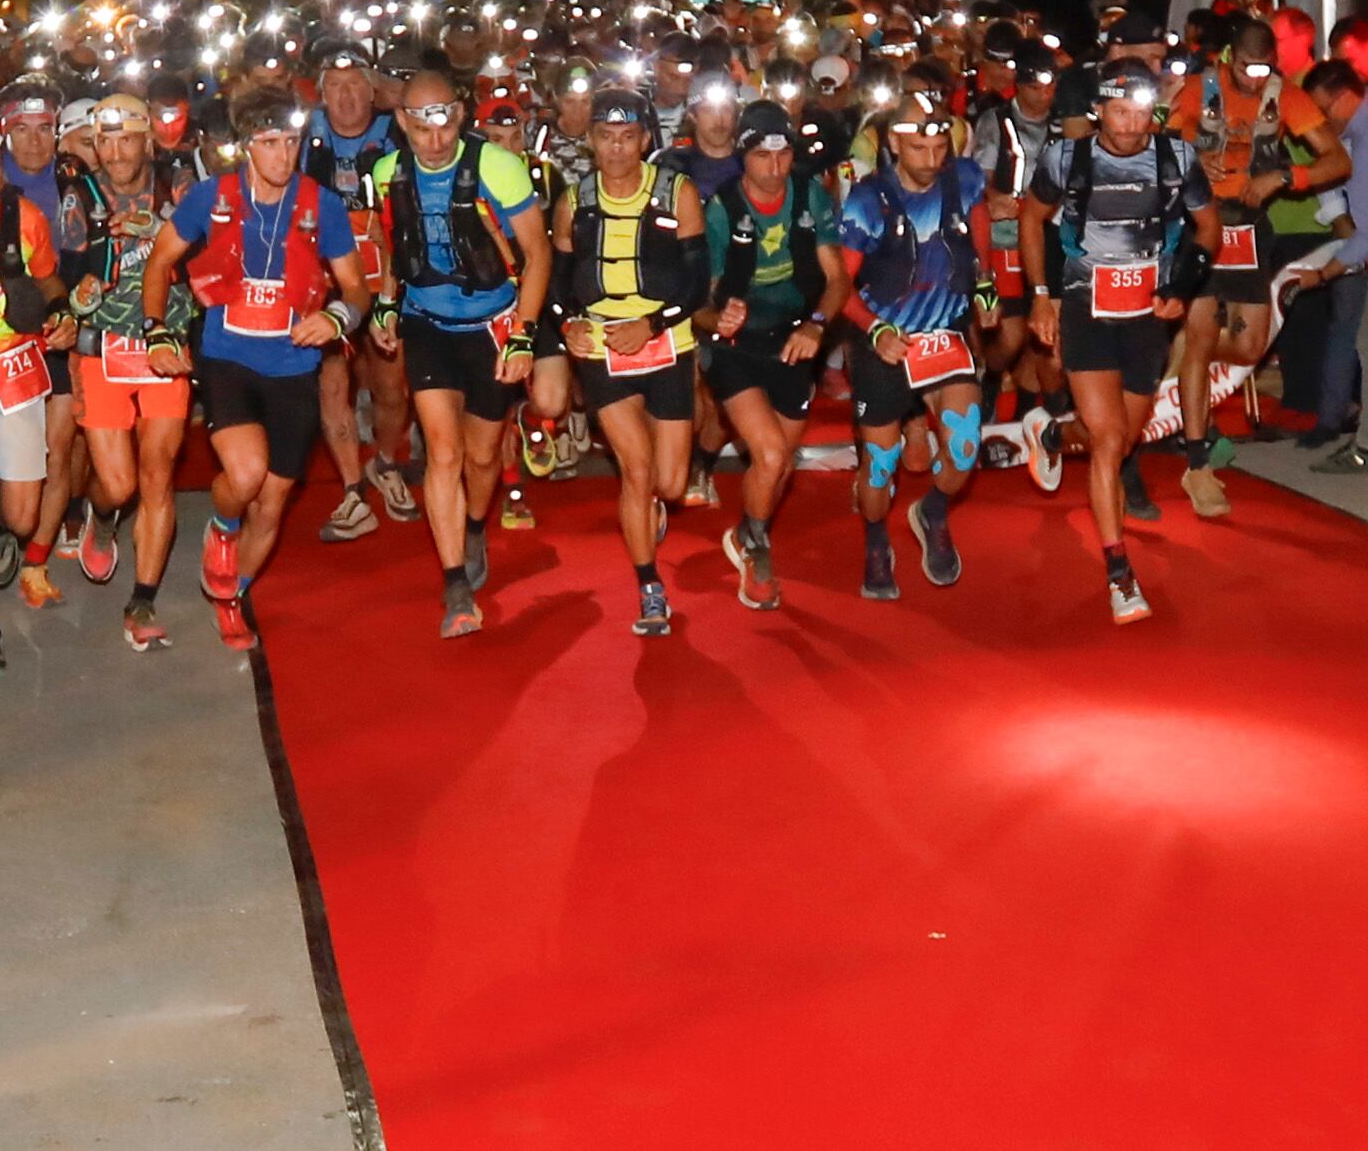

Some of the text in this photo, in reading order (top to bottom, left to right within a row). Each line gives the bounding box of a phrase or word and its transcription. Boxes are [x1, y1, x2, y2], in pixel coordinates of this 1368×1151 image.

[1111, 270, 1143, 288] 355
[918, 333, 951, 356] 279
[2, 352, 33, 378] 214
